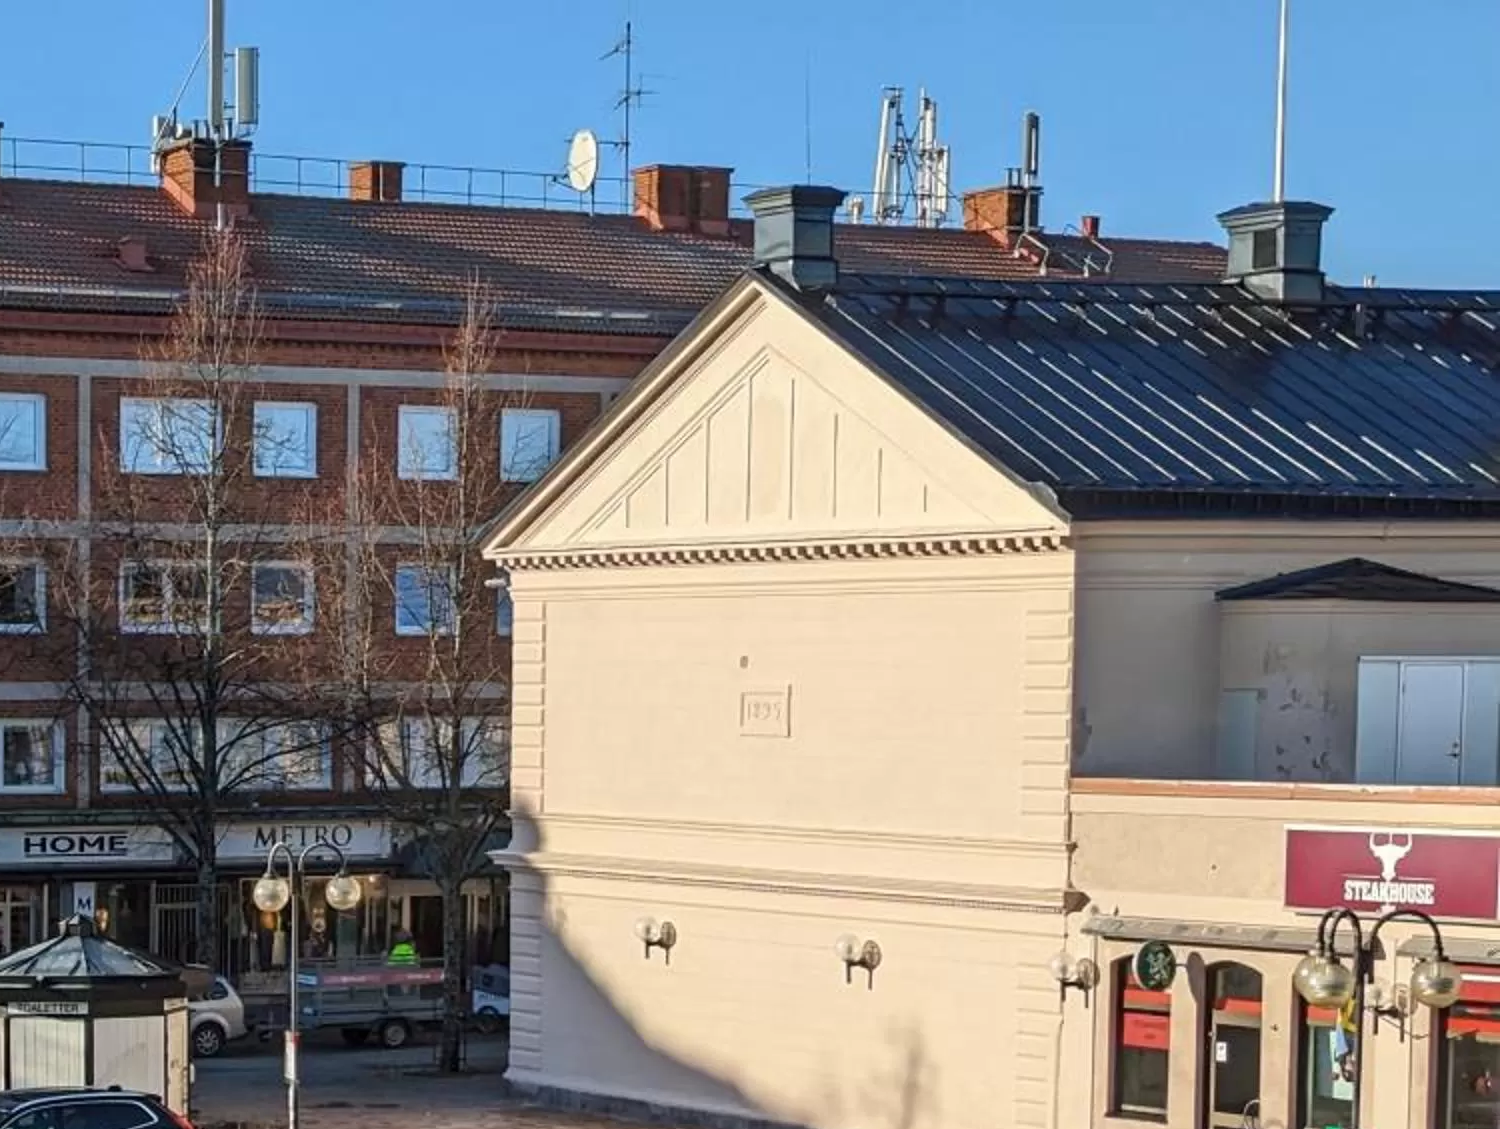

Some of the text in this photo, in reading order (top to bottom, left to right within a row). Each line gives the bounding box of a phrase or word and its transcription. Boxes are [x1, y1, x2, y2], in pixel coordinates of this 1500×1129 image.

[23, 835, 129, 853] HOME
[254, 824, 353, 848] METRO
[1343, 879, 1435, 905] STEAKHOUSE
[77, 896, 91, 911] M
